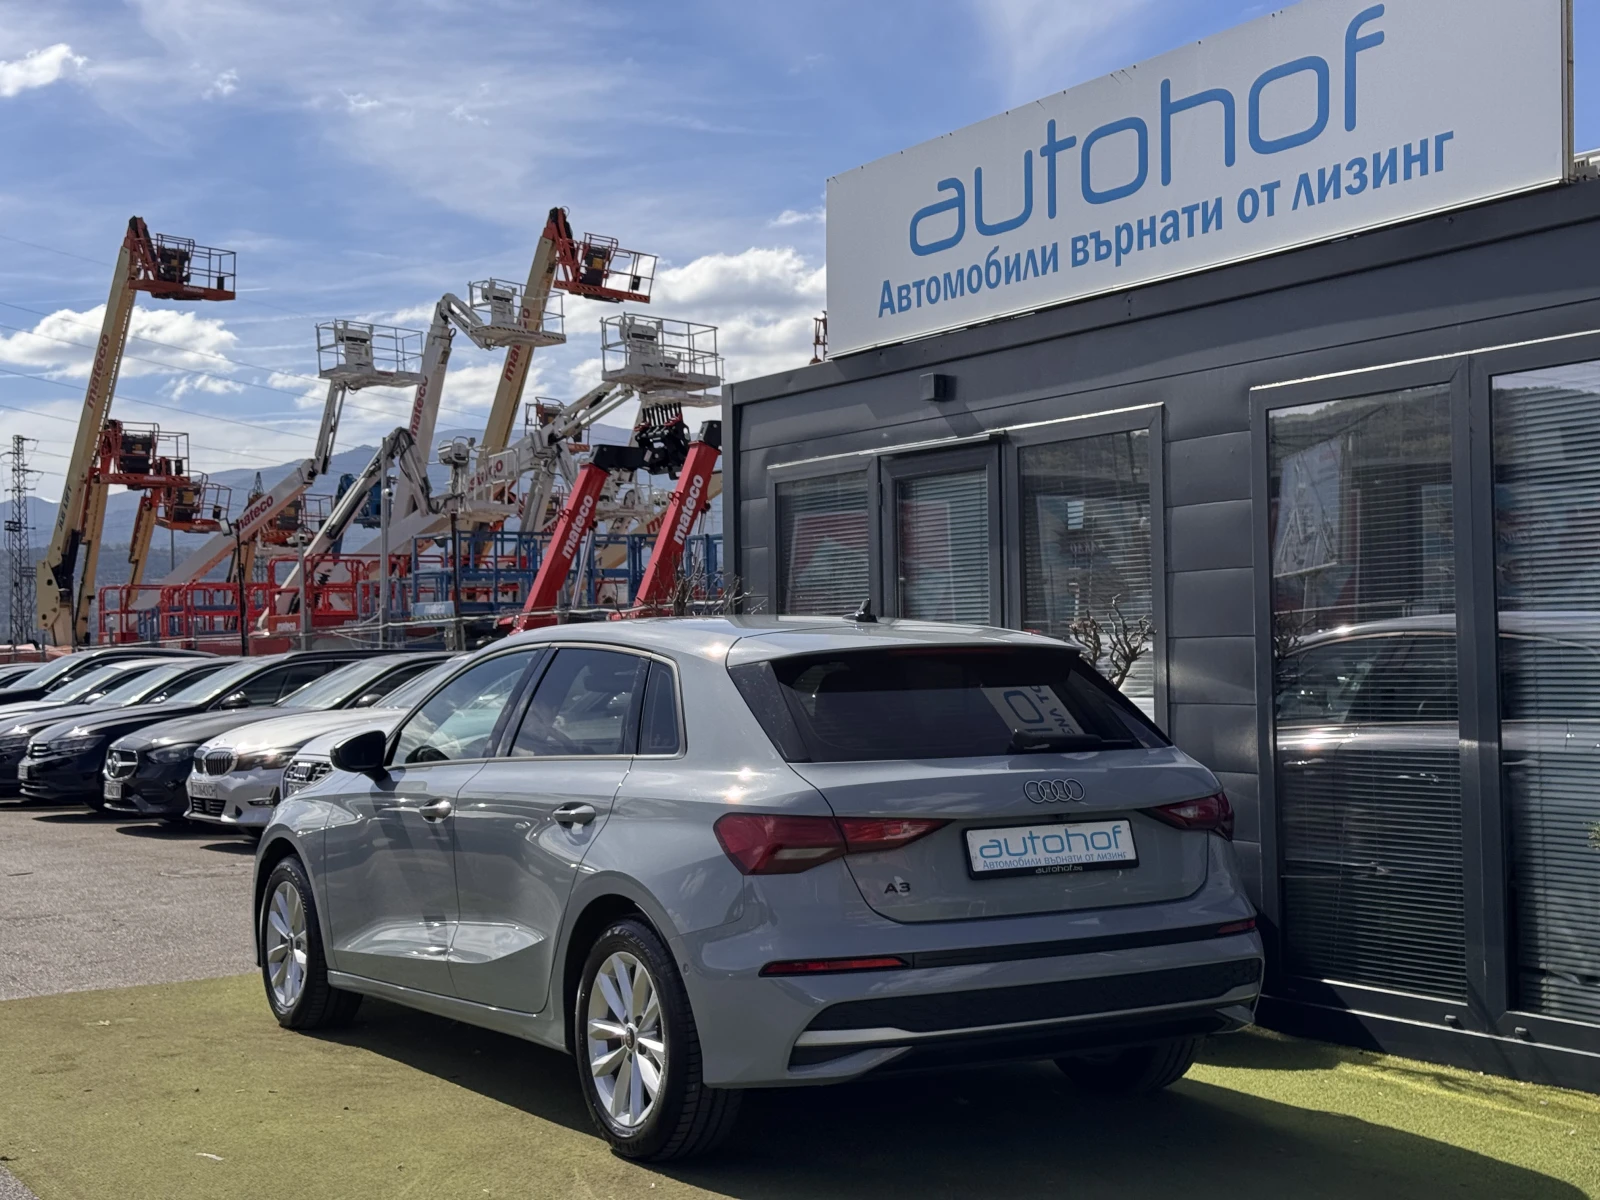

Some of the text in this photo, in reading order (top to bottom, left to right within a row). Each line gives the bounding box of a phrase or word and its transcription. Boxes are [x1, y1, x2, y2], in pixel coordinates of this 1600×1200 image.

[909, 4, 1385, 257] autohof
[878, 131, 1454, 318] Автомобили върнати от лизинг
[87, 334, 109, 409] mateco
[562, 495, 593, 560] mateco
[673, 474, 704, 546] mateco
[979, 825, 1122, 859] autohof
[982, 851, 1128, 870] Автомобили върнати от лизинг
[1035, 864, 1084, 875] autohof.bg
[884, 881, 911, 895] A3
